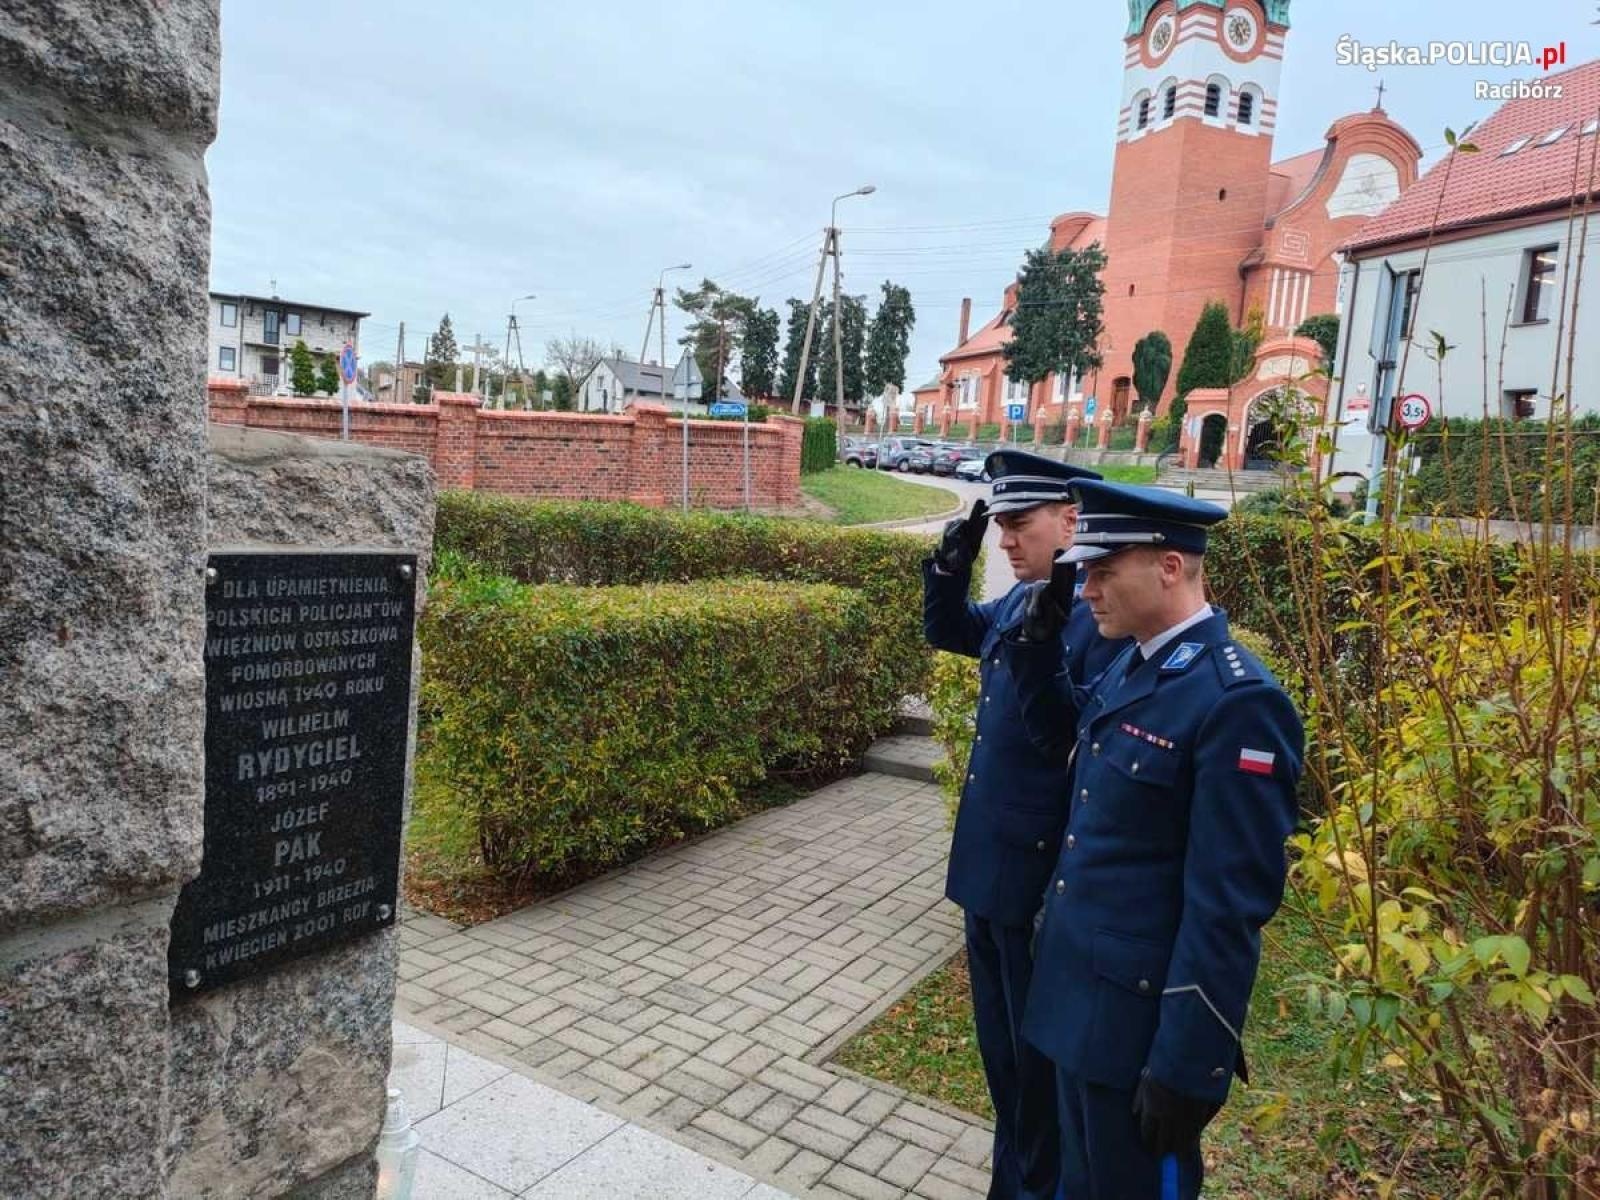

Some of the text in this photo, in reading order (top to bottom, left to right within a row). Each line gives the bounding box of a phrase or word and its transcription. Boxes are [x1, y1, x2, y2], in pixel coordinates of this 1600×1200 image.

[1011, 407, 1022, 419] P
[223, 576, 389, 598] DLA UPAMIĘTNIENIA
[207, 606, 292, 627] POLSKICH
[304, 627, 397, 649] OSTASZKOWA
[231, 653, 376, 683] POMORDOWANYCH
[295, 682, 337, 702] 1940
[345, 676, 384, 695] ROKU
[262, 709, 349, 740] WILHELM
[238, 735, 361, 780] RYDYGIEL
[271, 803, 329, 832] JÓZEF
[274, 832, 321, 867] PAK
[317, 876, 375, 908] BRZEZIA
[293, 913, 335, 941] 2001
